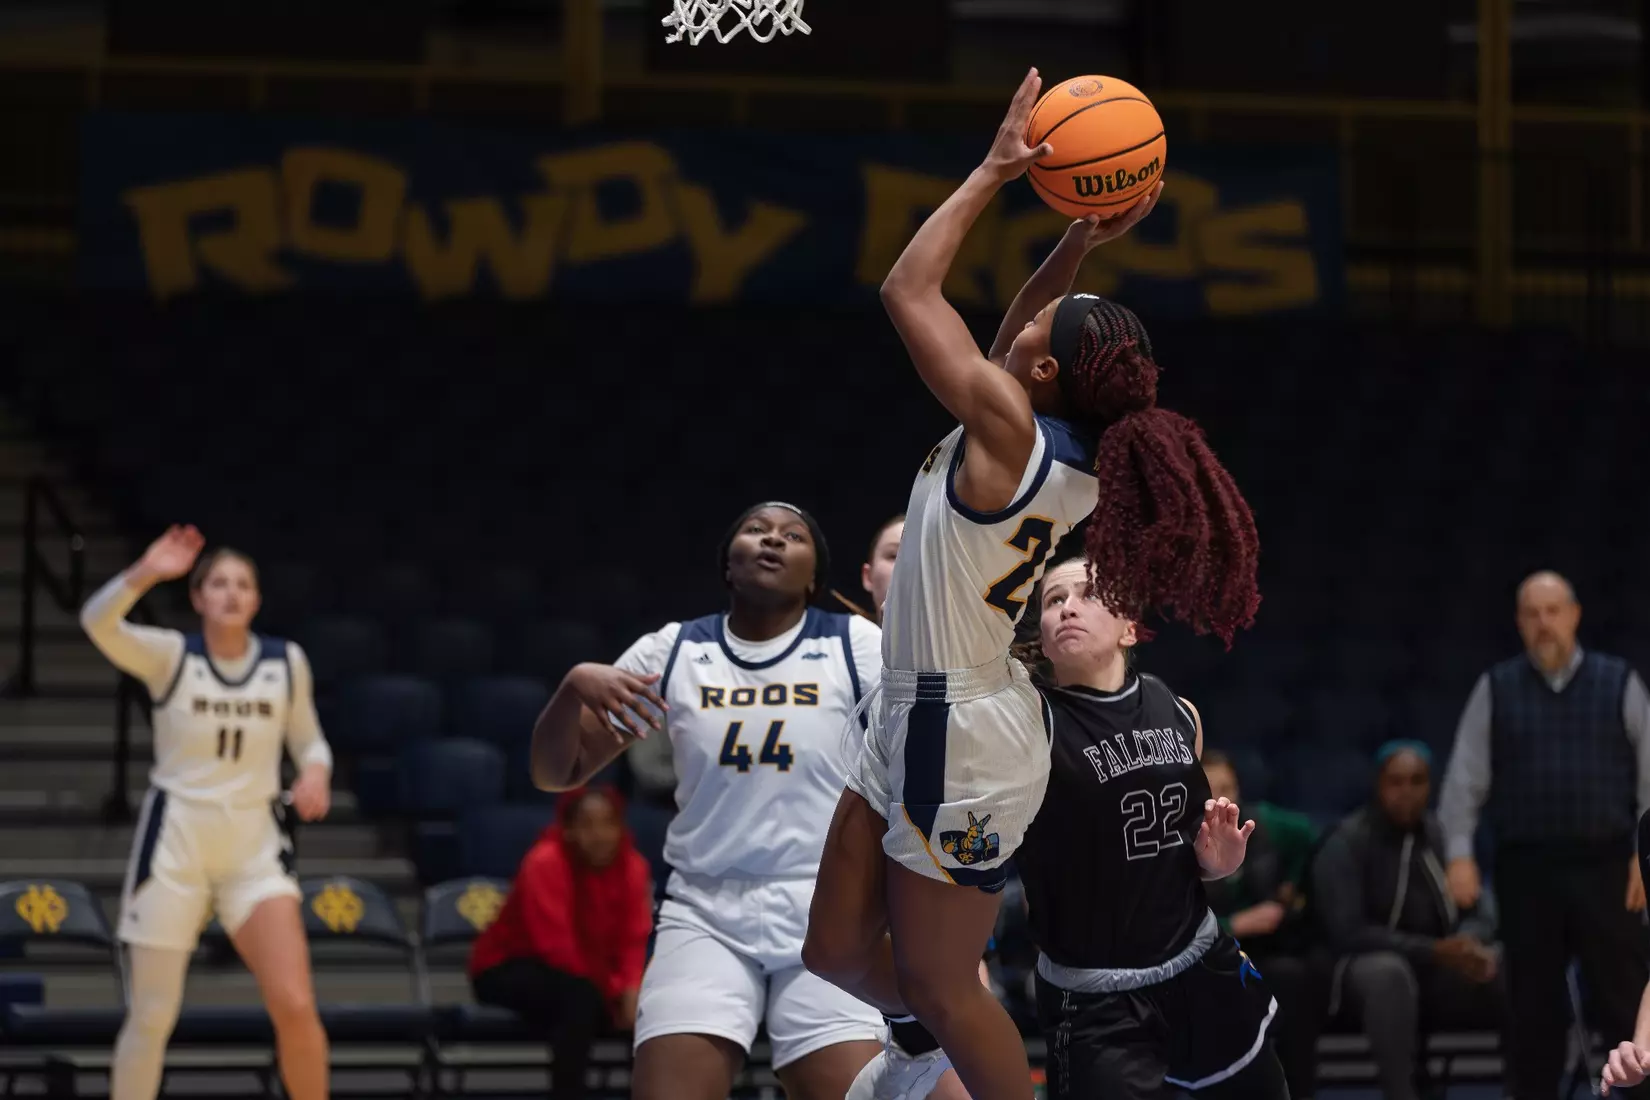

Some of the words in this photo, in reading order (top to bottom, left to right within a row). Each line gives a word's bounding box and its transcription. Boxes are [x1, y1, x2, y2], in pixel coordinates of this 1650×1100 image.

[1072, 156, 1160, 197] Wilson
[118, 142, 808, 306] ROWDY
[698, 681, 820, 709] ROOS
[216, 726, 243, 762] 11
[717, 720, 795, 773] 44
[1083, 727, 1194, 784] FALCONS
[1120, 782, 1188, 861] 22
